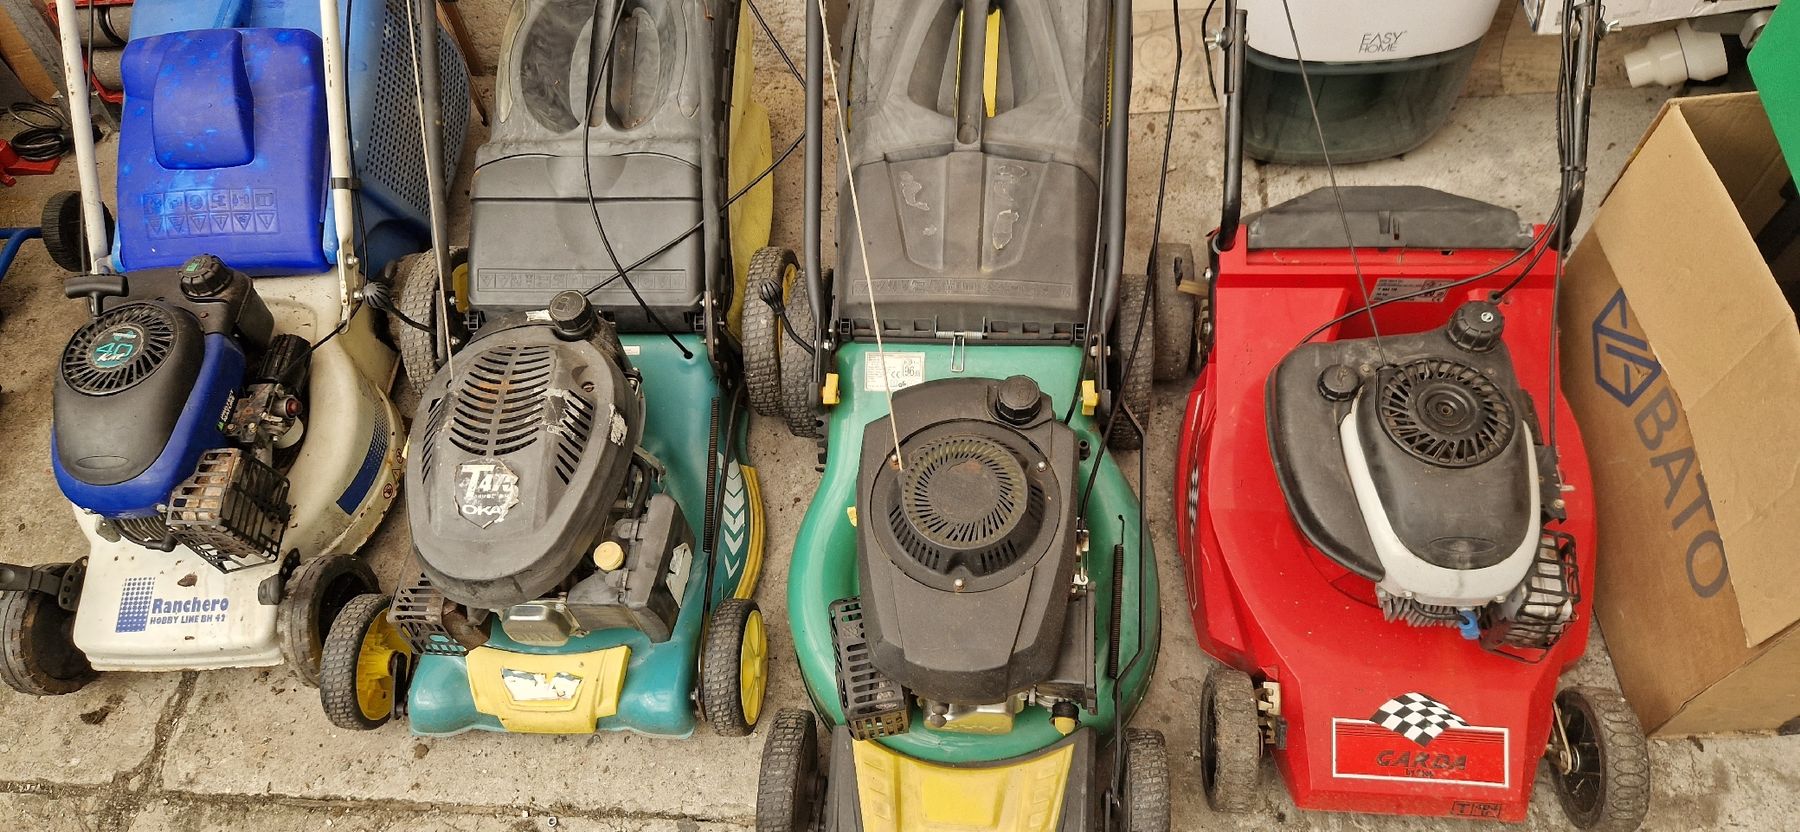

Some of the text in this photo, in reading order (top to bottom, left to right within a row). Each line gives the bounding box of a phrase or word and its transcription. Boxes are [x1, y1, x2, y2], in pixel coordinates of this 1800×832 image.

[1361, 31, 1403, 44] EASY
[1359, 43, 1397, 53] HOME
[96, 343, 133, 357] 40
[1634, 387, 1729, 598] BATO
[151, 597, 229, 613] Ranchero
[150, 616, 179, 625] HOBBY
[180, 615, 200, 624] LINE
[200, 614, 213, 623] BH
